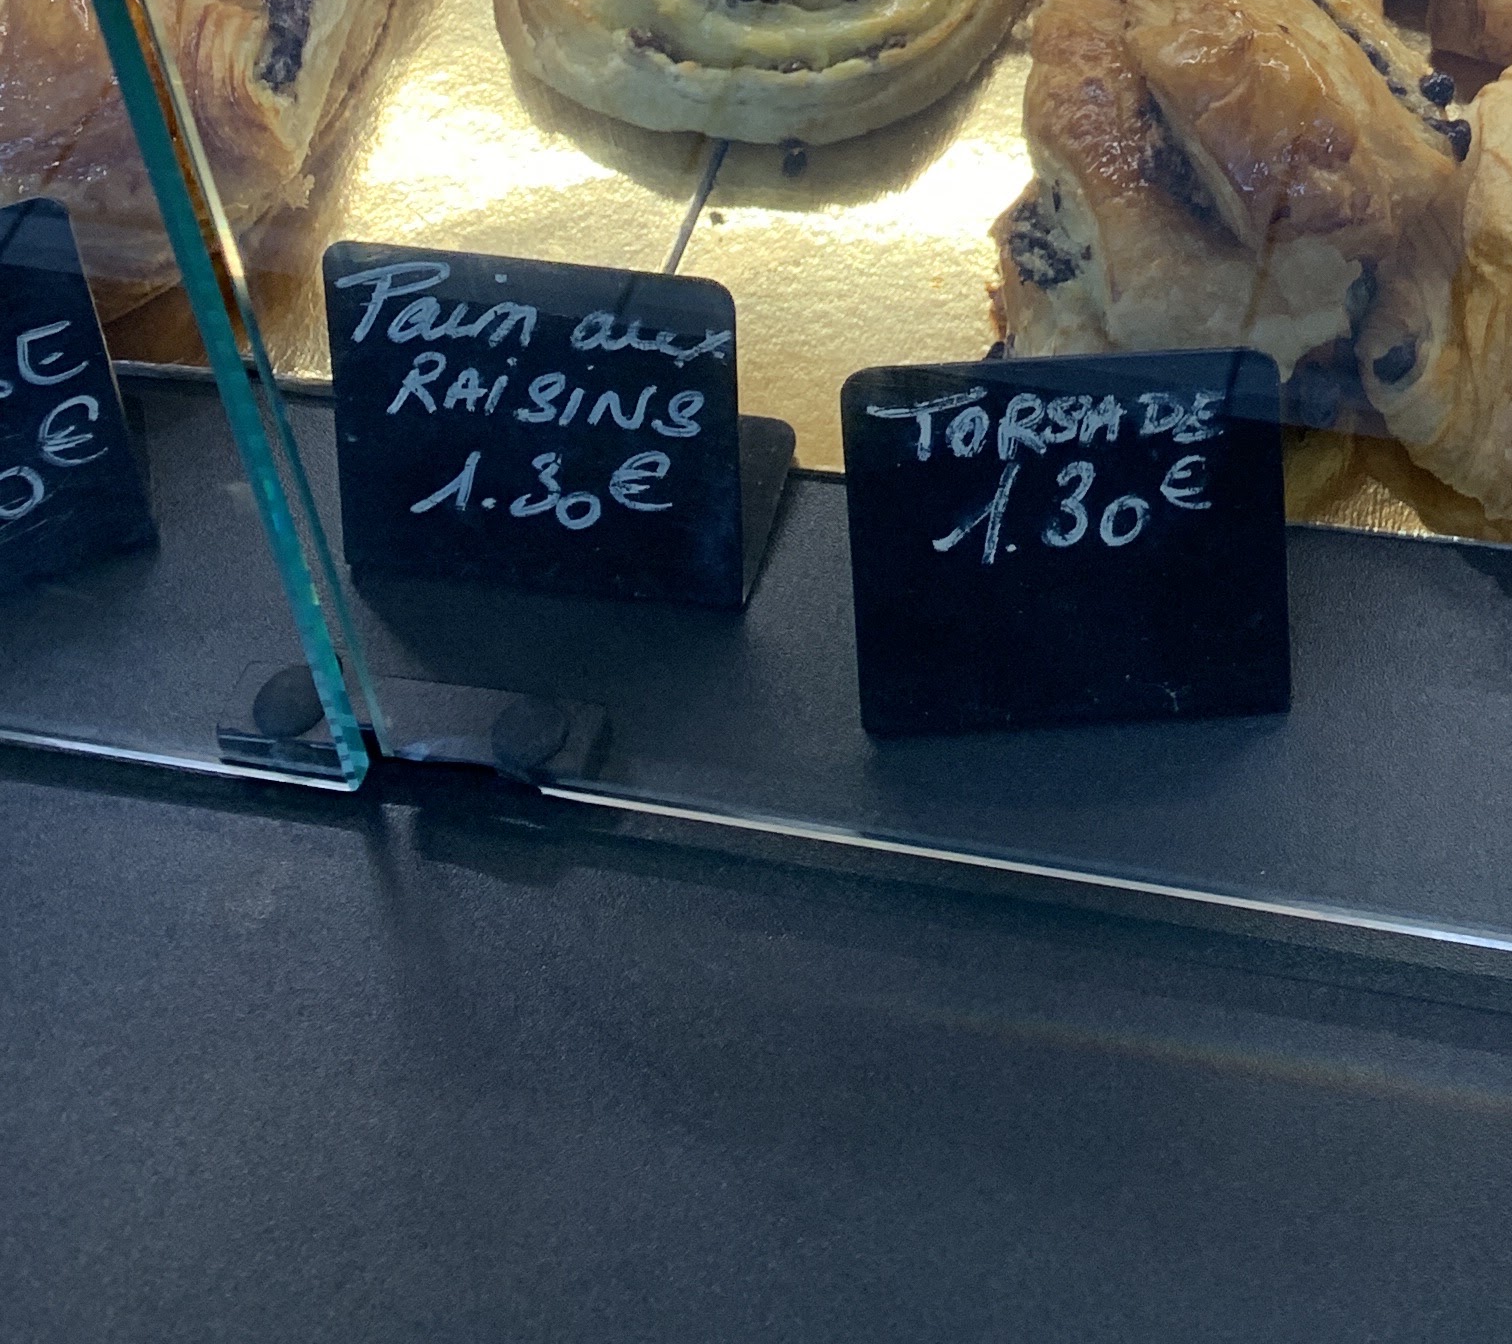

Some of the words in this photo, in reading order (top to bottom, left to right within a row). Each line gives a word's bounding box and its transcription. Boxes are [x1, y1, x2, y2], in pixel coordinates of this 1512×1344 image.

[335, 261, 538, 348] Pain
[570, 310, 732, 368] aux
[866, 386, 1226, 462] TORSADE
